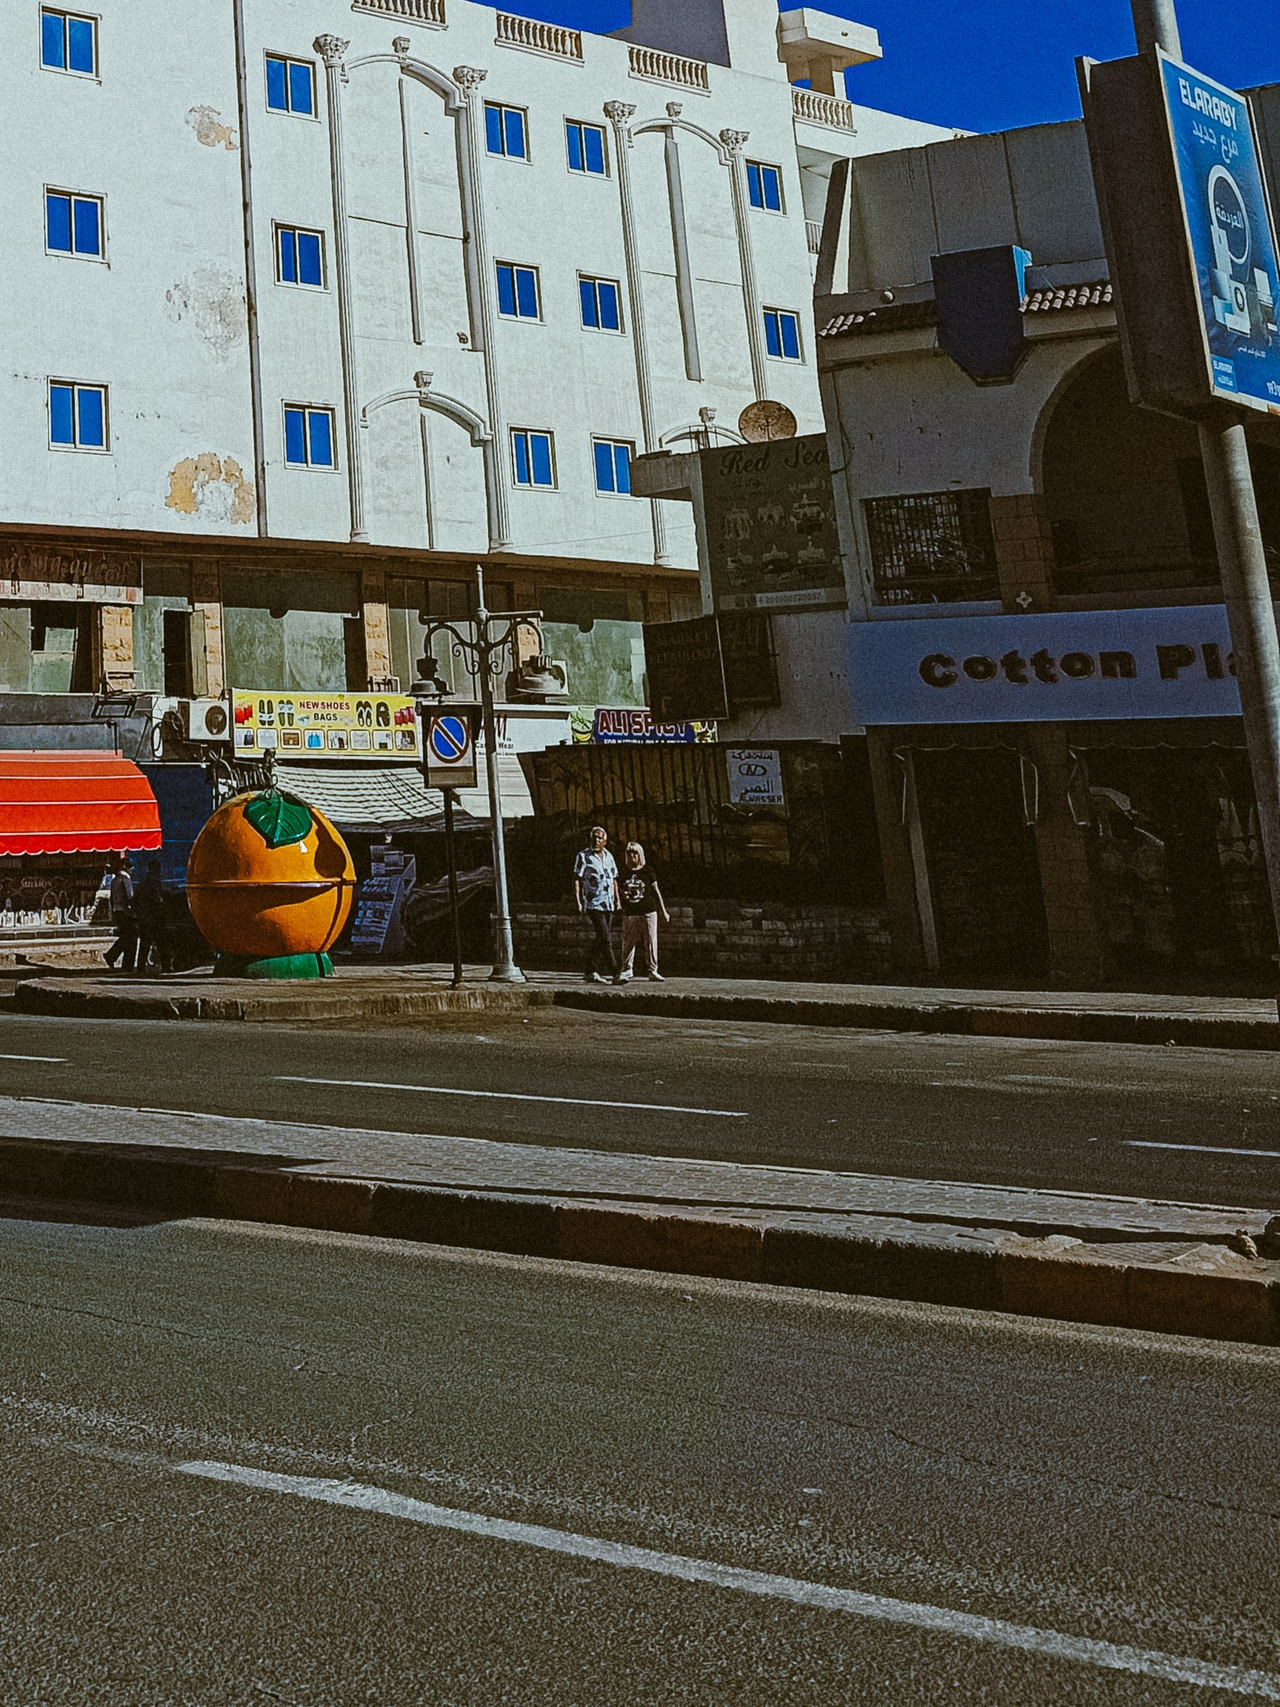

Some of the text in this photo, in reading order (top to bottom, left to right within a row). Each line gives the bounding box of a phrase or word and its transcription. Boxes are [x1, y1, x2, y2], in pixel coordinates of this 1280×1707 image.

[1178, 77, 1238, 132] ELARABY
[1192, 120, 1239, 165] فرع جديد
[720, 441, 829, 476] Red Sea
[919, 648, 1138, 688] Cotton
[299, 700, 351, 711] NEW SHOES
[313, 712, 339, 722] BAGS
[598, 710, 629, 736] ALI
[740, 779, 774, 795] النصر
